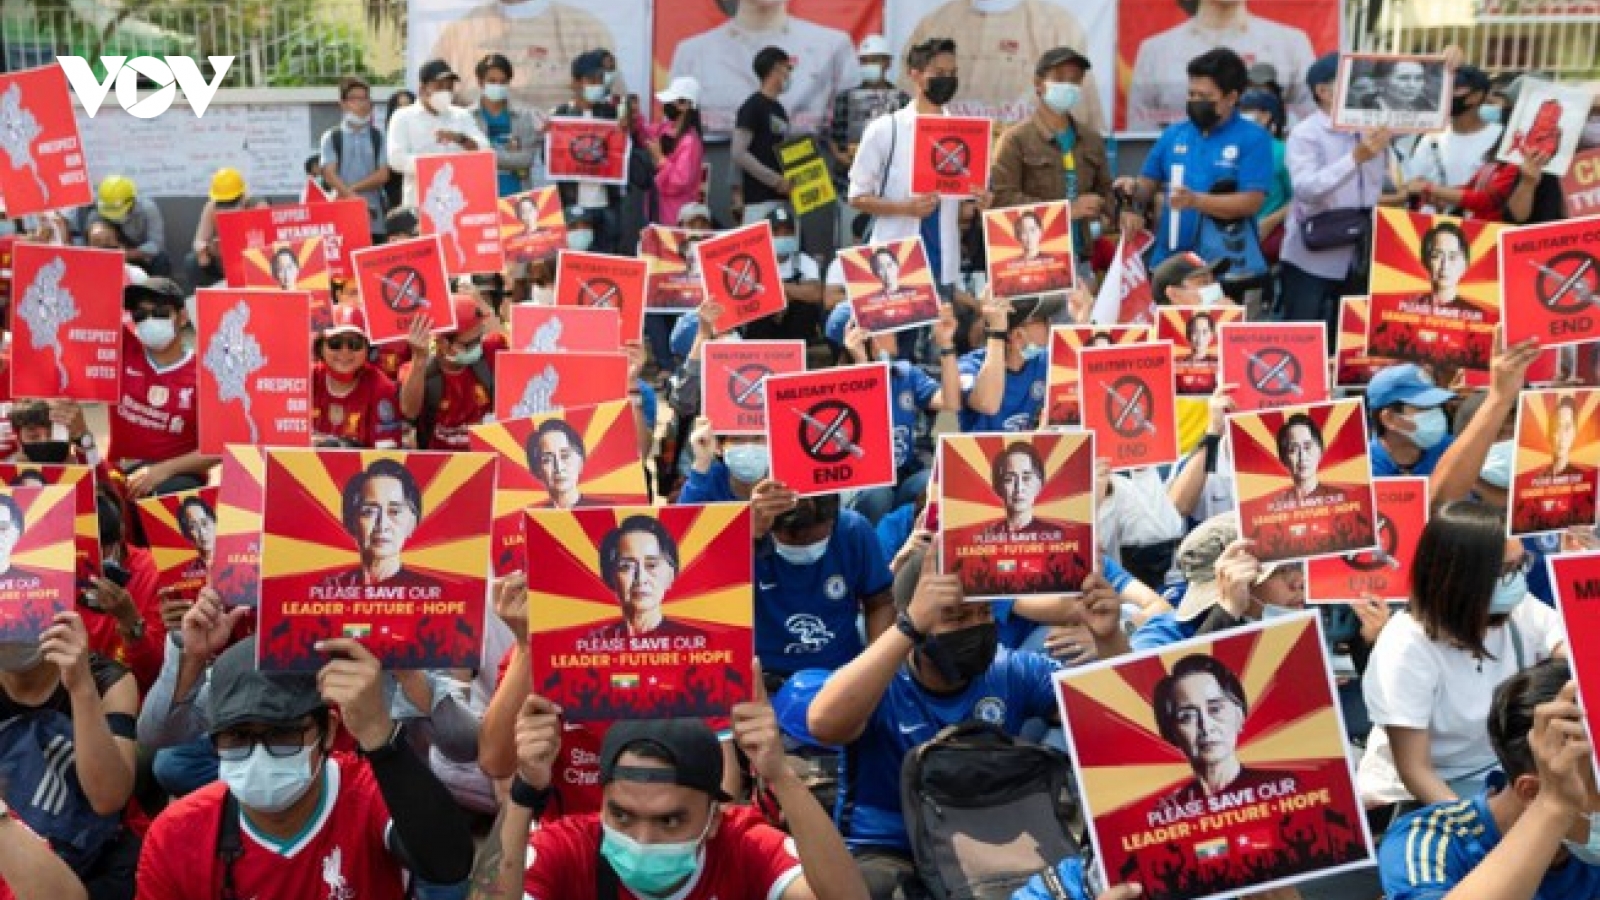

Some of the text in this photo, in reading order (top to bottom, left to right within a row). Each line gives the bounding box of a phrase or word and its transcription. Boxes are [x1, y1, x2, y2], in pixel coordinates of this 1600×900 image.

[1512, 233, 1578, 253] MILITARY
[1549, 317, 1593, 335] END
[69, 329, 118, 343] #RESPECT
[97, 348, 116, 361] OUR
[85, 366, 116, 379] VOTES
[256, 378, 308, 392] #RESPECT
[776, 378, 879, 401] MILITARY COUP
[287, 398, 308, 413] OUR
[275, 417, 308, 432] VOTES
[1117, 442, 1148, 459] END
[812, 464, 854, 485] END
[309, 586, 441, 599] PLEASE SAVE OUR
[281, 601, 466, 615] LEADER FUTURE HOPE
[576, 634, 706, 652] PLEASE SAVE OUR
[550, 650, 733, 669] LEADER FUTURE HOPE
[1147, 777, 1297, 828] PLEASE SAVE OUR
[1121, 788, 1331, 852] LEADER FUTURE HOPE
